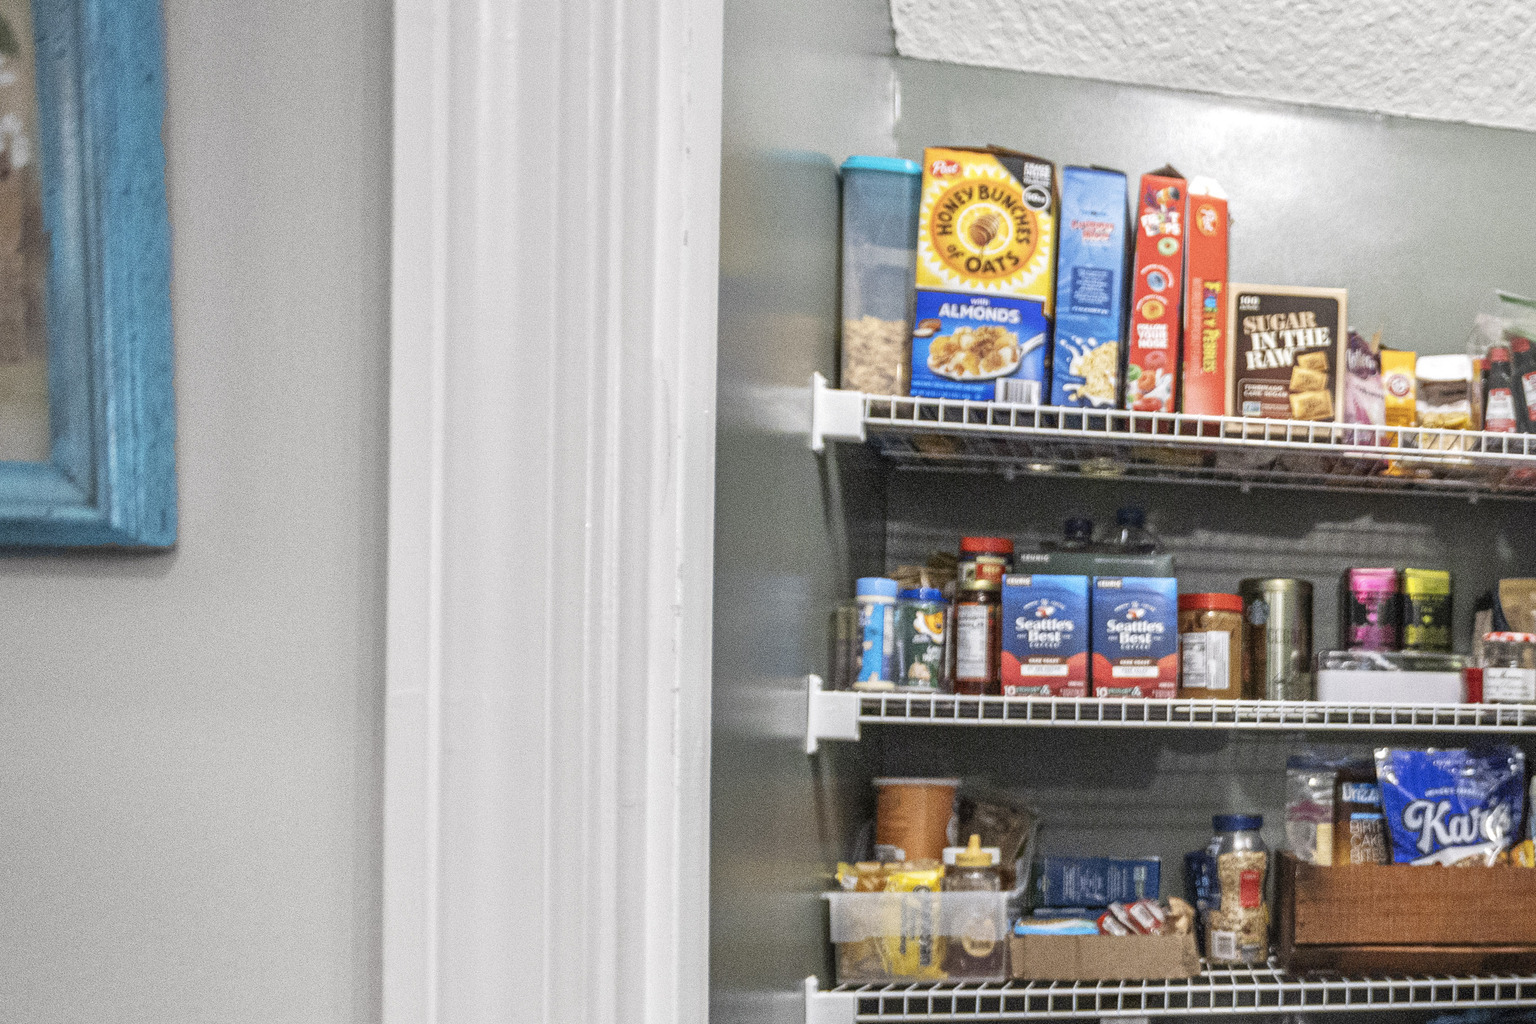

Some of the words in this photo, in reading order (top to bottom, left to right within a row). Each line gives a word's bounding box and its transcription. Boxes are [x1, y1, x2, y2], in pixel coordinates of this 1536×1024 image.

[932, 159, 960, 177] Post
[936, 186, 974, 236] HONEY
[979, 184, 1032, 245] BUNCHES
[964, 250, 1020, 274] OATS
[938, 302, 1021, 324] ALMONDS
[1243, 311, 1318, 335] SUGAR
[1251, 331, 1279, 351] IN
[1279, 326, 1332, 349] THE
[1245, 347, 1297, 371] RAW
[1028, 629, 1062, 643] Best
[1119, 632, 1152, 645] Best
